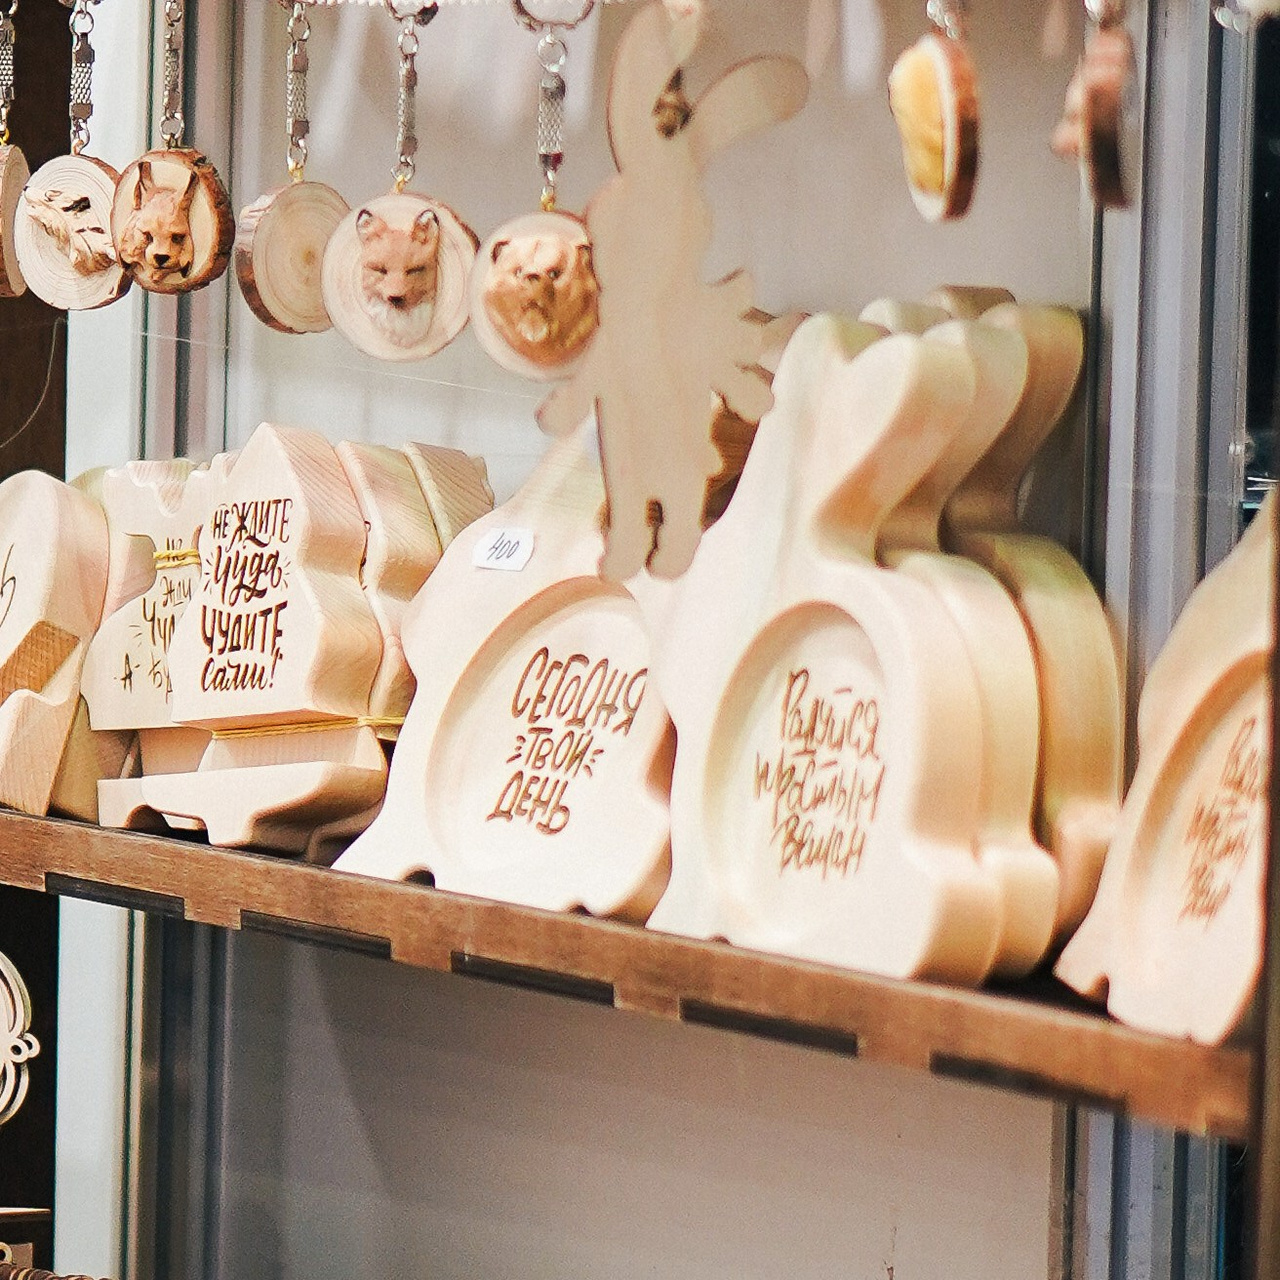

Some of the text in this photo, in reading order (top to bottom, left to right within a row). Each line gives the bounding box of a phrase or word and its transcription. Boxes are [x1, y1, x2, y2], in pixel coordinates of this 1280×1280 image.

[487, 532, 520, 561] 400
[511, 646, 649, 737] СЕГОДНЯ
[525, 726, 595, 778] ТВОЙ
[485, 770, 571, 835] ДЕНЬ
